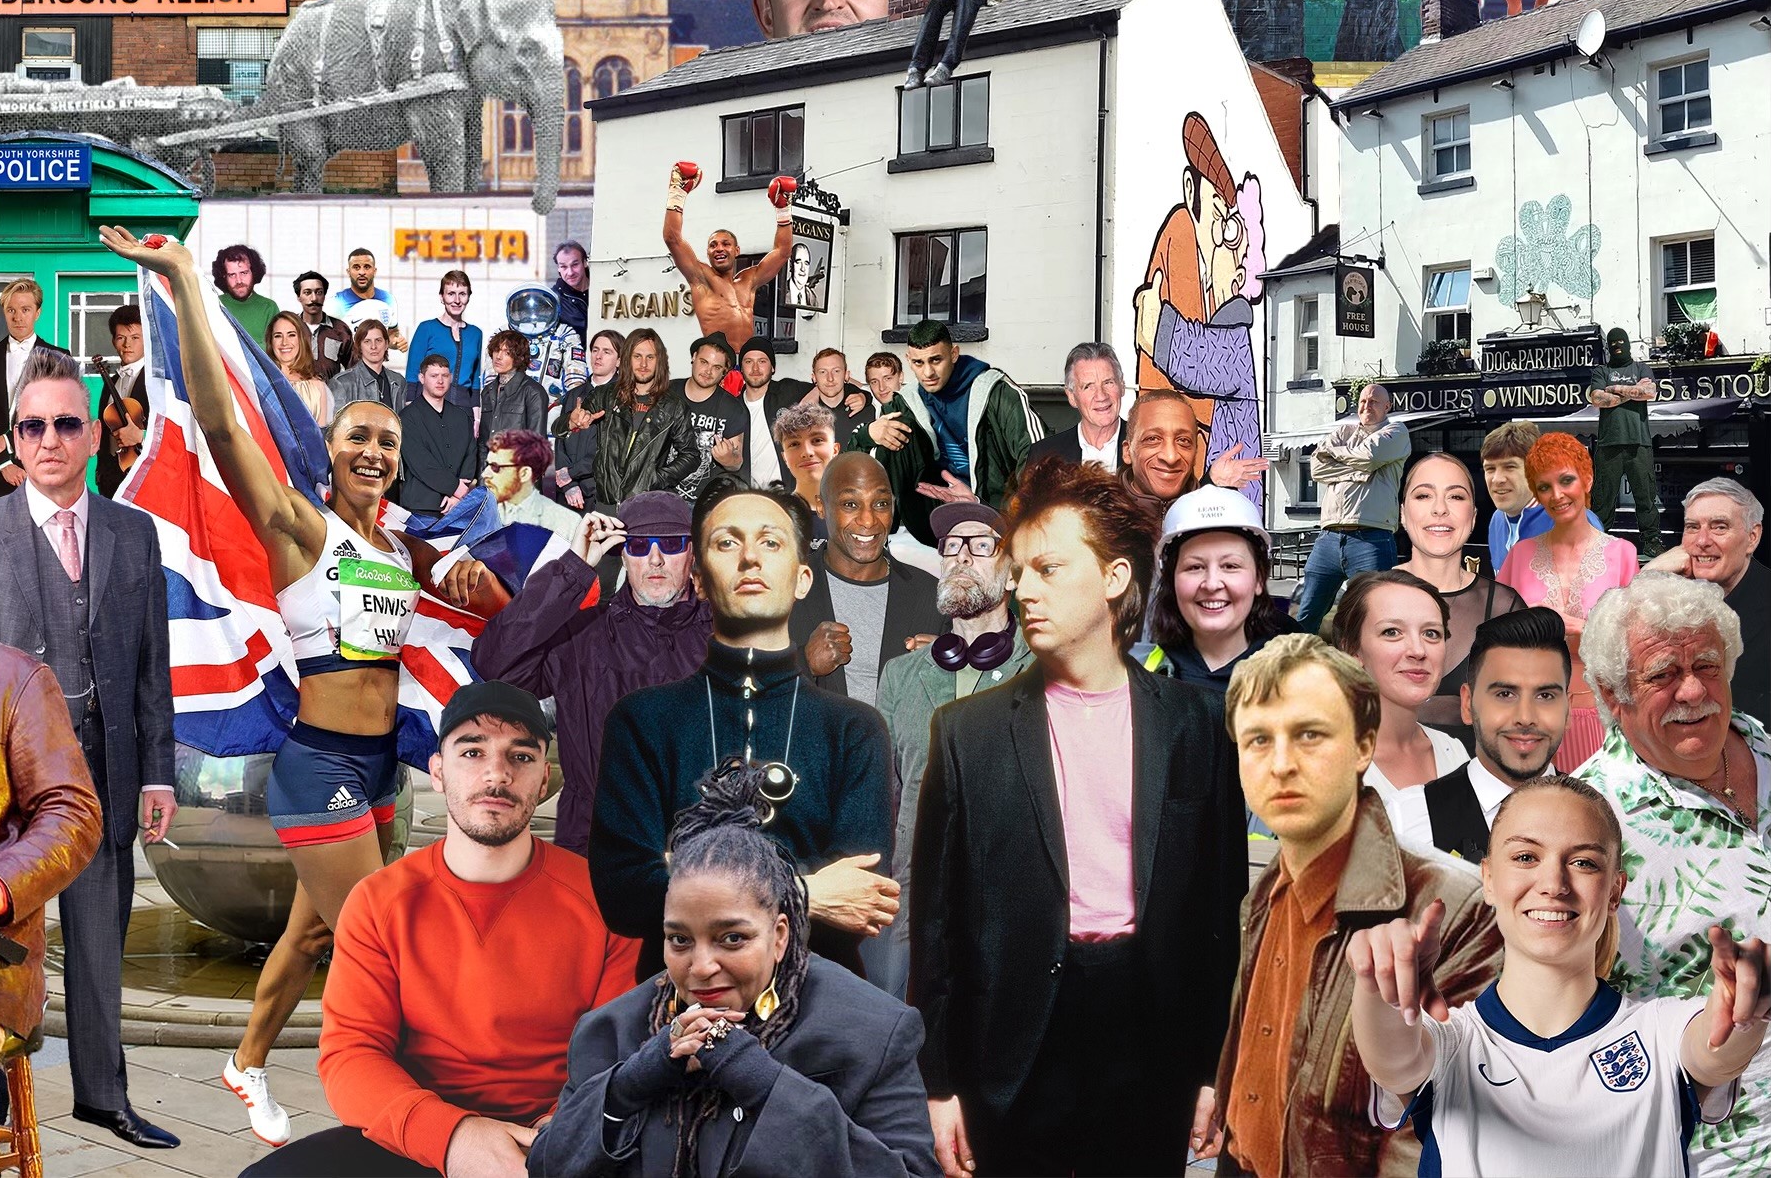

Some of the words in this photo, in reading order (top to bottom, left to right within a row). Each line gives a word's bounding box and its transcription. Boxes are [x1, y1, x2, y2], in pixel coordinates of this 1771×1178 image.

[26, 149, 81, 159] YORKSHIRE
[600, 283, 696, 320] FAGAN'S
[1346, 311, 1366, 321] FREE
[1342, 322, 1370, 333] HOUSE
[1393, 388, 1474, 413] MOURS
[1499, 383, 1583, 408] WINDSOR
[332, 549, 362, 560] adidas
[325, 566, 339, 581] G
[327, 798, 358, 811] adidas
